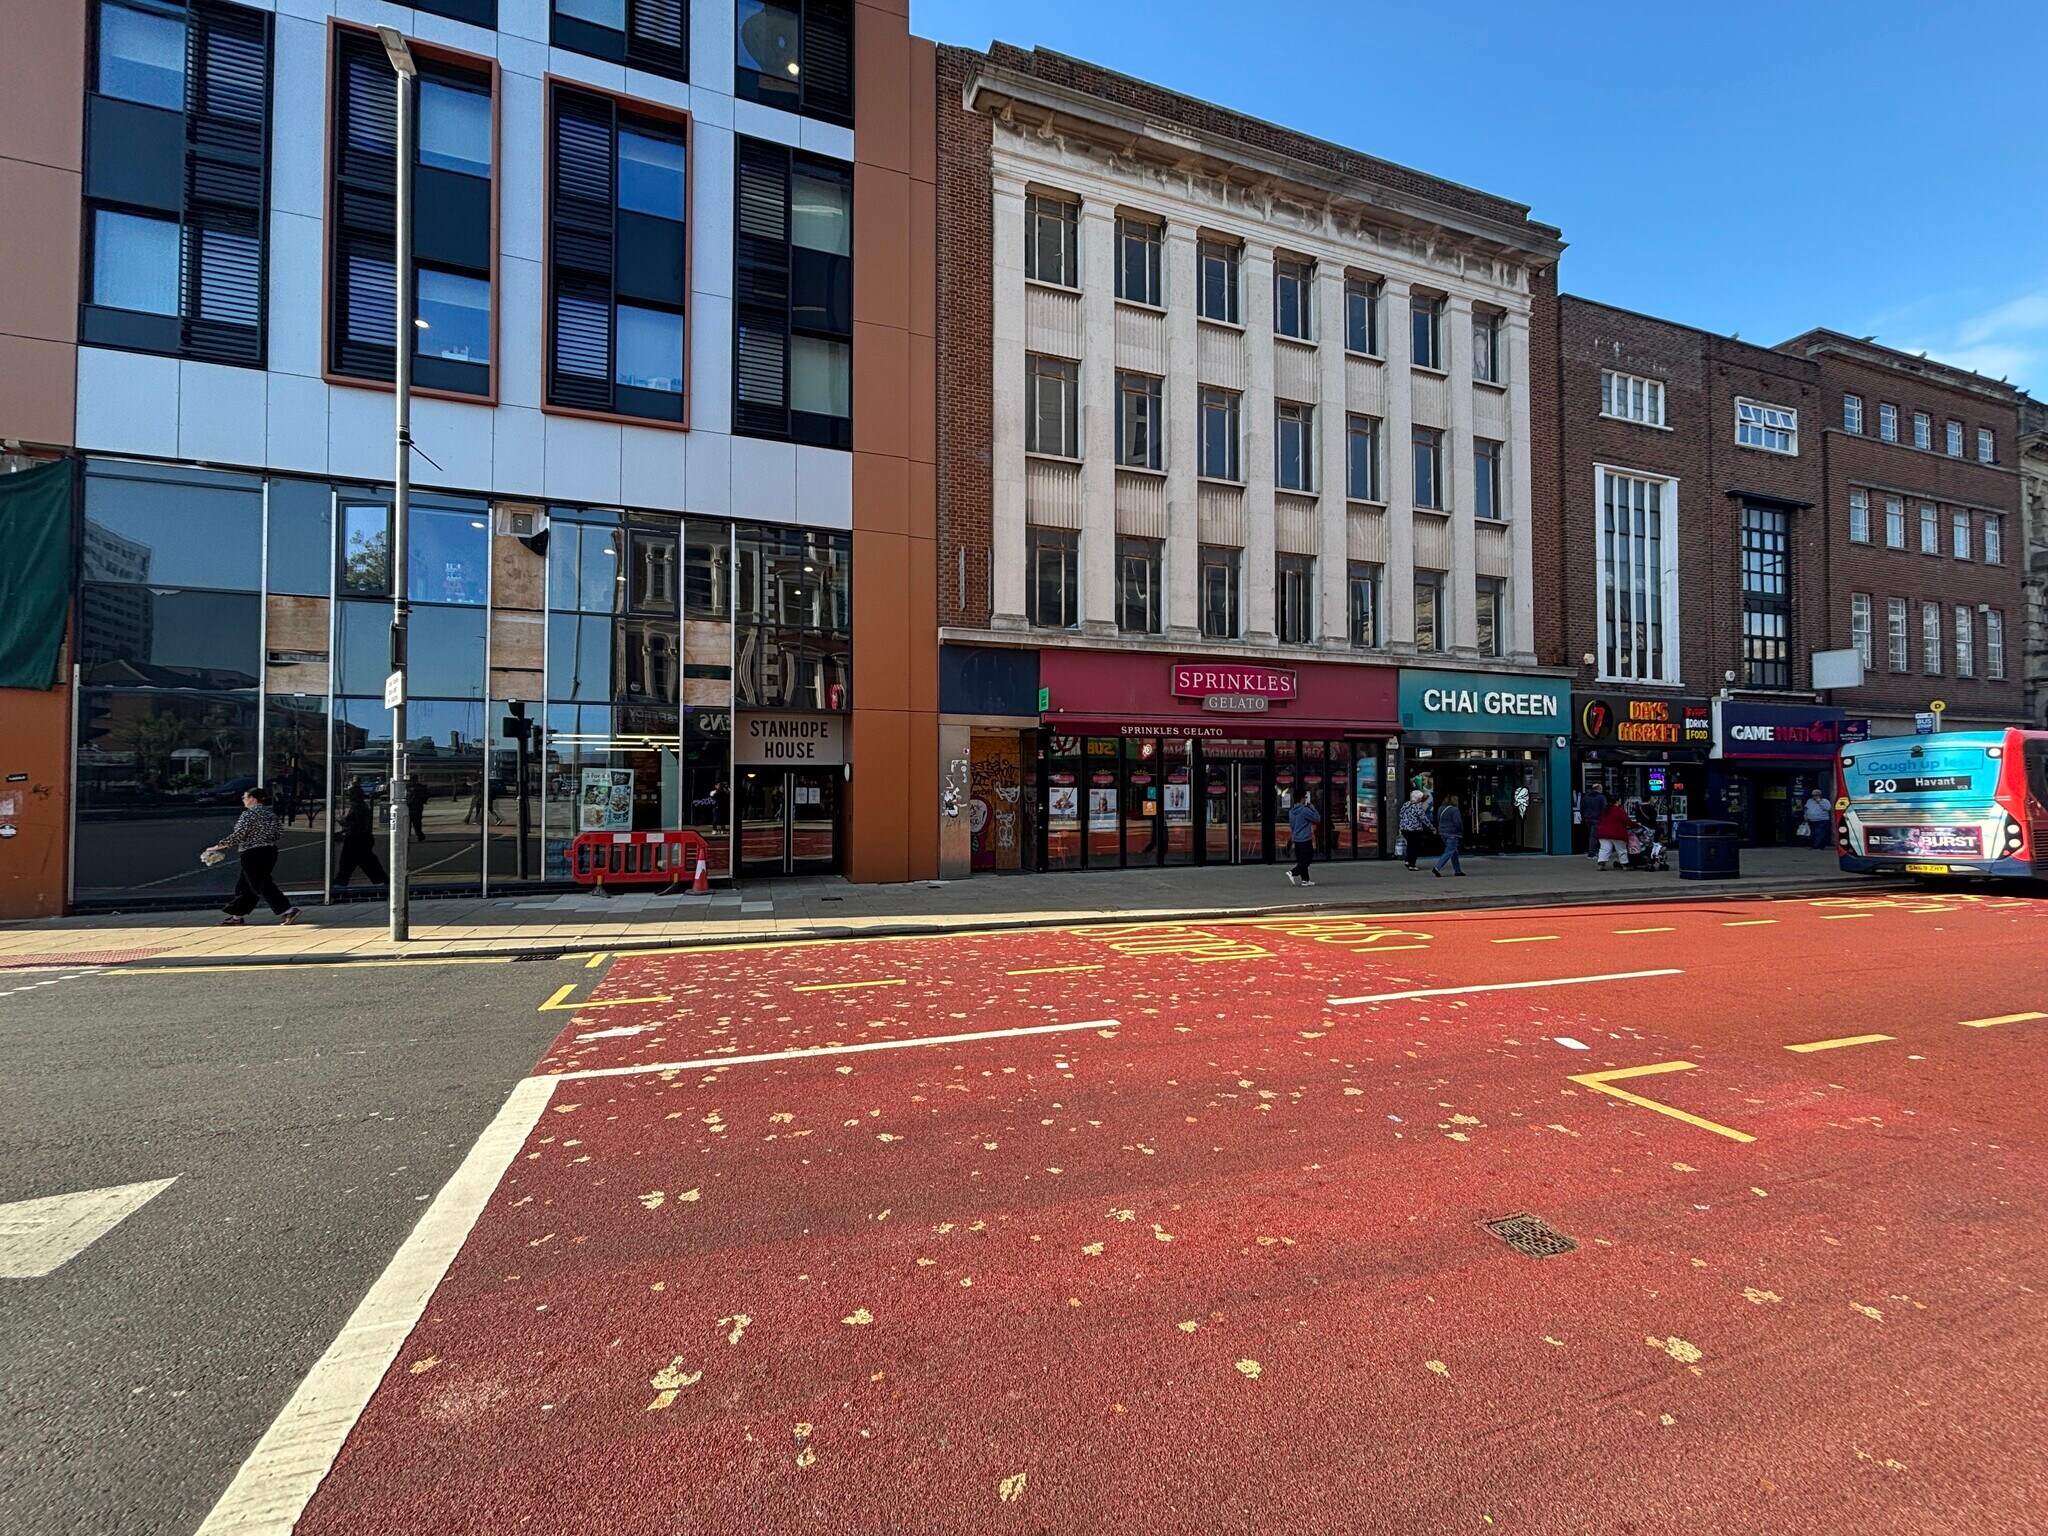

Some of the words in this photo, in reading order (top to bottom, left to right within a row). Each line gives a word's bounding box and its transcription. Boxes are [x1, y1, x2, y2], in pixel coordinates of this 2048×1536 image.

[1179, 672, 1290, 691] SPRINKLES
[1208, 697, 1265, 709] GELATO
[1424, 689, 1479, 713] CHAI
[1484, 692, 1557, 716] GREEN
[1629, 701, 1668, 720] DAYS
[750, 720, 828, 738] STANHOPE
[1593, 707, 1605, 735] 7
[1689, 718, 1709, 728] DRINK
[1121, 726, 1179, 735] SPRINKLES
[1183, 727, 1223, 736] GELATO
[1618, 722, 1680, 742] MARKET
[1690, 730, 1708, 739] FOOD
[1731, 725, 1774, 741] GAME
[764, 742, 815, 759] HOUSE
[1868, 760, 1916, 771] Cough
[1920, 760, 1940, 769] up
[1874, 780, 1897, 793] 20
[1915, 777, 1956, 787] Havant
[1922, 836, 1977, 847] BURST
